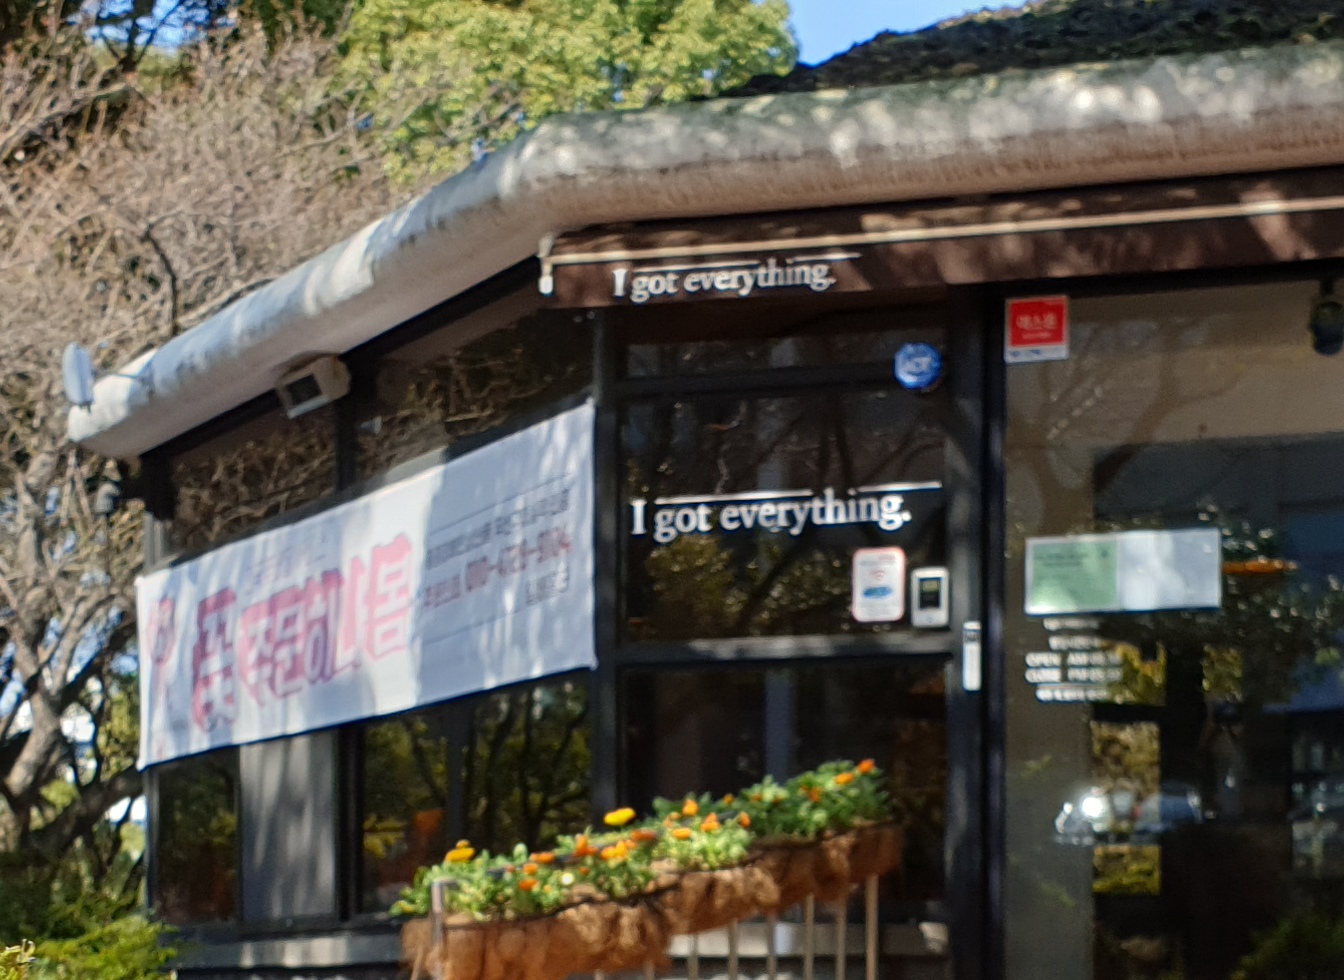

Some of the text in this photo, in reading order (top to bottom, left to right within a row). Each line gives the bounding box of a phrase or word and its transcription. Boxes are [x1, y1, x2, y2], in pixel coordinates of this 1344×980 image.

[613, 256, 837, 304] I got everything.
[630, 486, 913, 543] I got everything.
